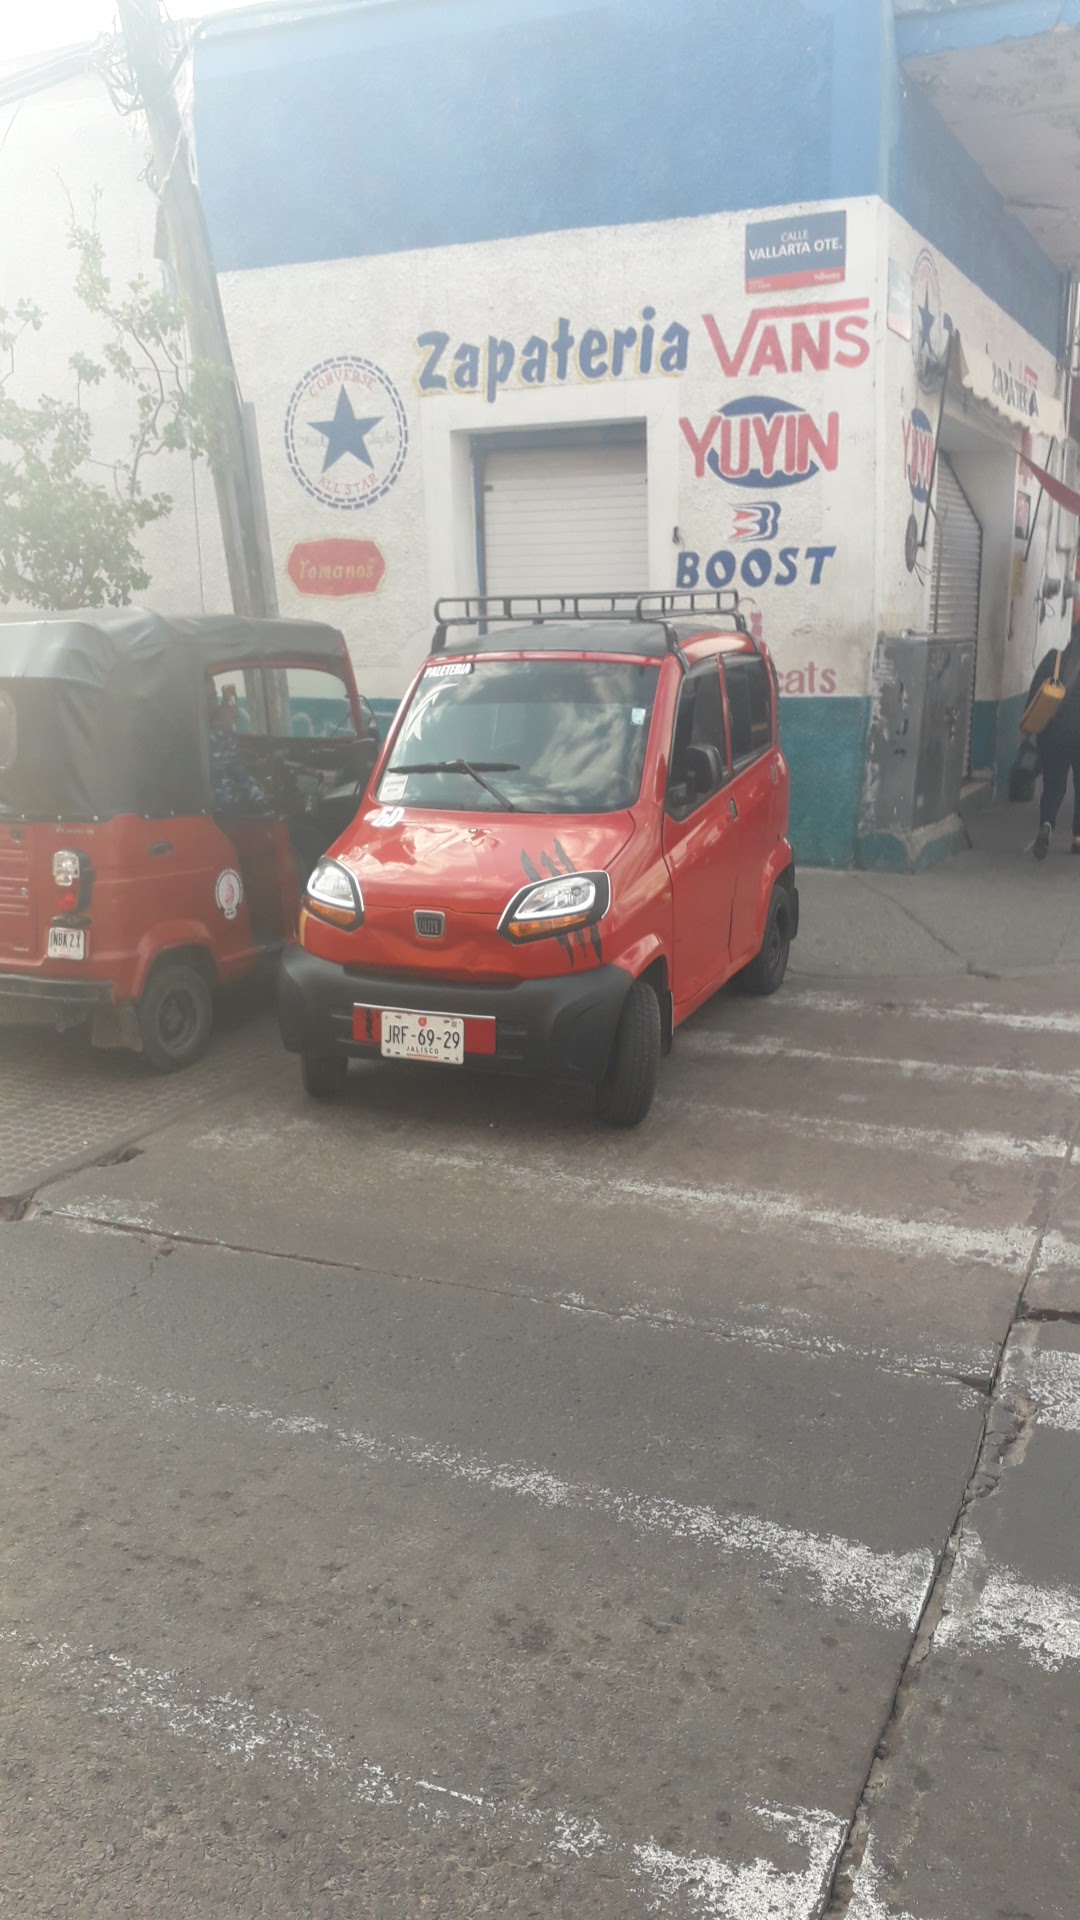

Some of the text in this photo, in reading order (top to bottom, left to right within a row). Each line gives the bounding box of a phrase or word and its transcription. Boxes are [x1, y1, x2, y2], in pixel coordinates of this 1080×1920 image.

[781, 229, 808, 242] CALLE
[749, 237, 843, 261] VALLARTA OTE.
[701, 297, 870, 378] VANS
[416, 305, 690, 404] Zapateria
[308, 368, 377, 398] CONVERSE
[678, 411, 839, 479] YUYIN
[318, 473, 379, 495] ALL STAR
[676, 545, 837, 589] BOOST
[423, 663, 472, 679] PALETERIA
[384, 1024, 460, 1050] JRF-69-29
[405, 1045, 439, 1055] JALISCO
